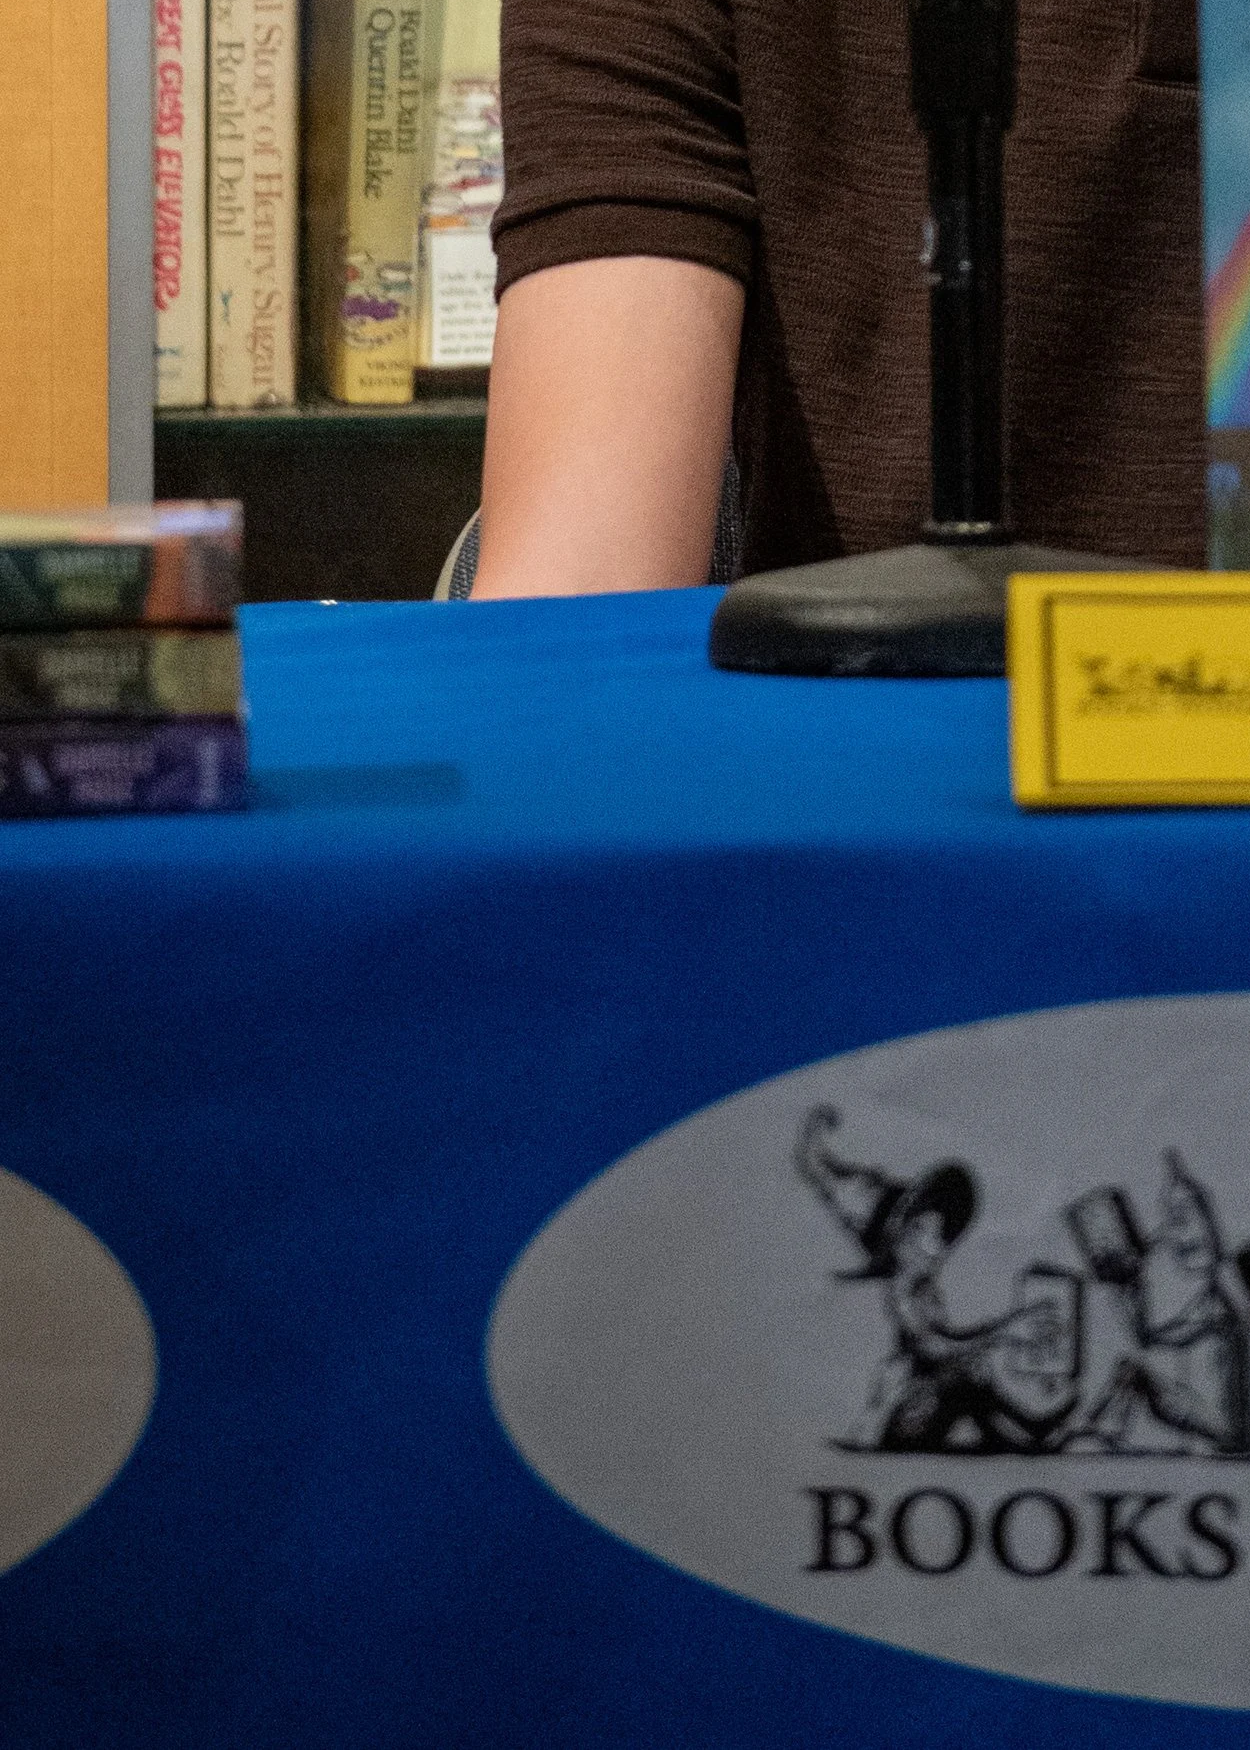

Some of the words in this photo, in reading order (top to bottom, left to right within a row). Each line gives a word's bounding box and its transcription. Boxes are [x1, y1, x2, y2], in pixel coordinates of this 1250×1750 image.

[215, 40, 247, 141] Roald
[250, 23, 283, 114] Story
[365, 7, 396, 125] Quentin
[253, 124, 284, 161] of
[362, 127, 393, 200] Blake
[215, 154, 247, 239] Dahl
[247, 171, 284, 285] Henry
[245, 287, 283, 390] Sugar
[802, 1486, 1240, 1584] BOOKS
